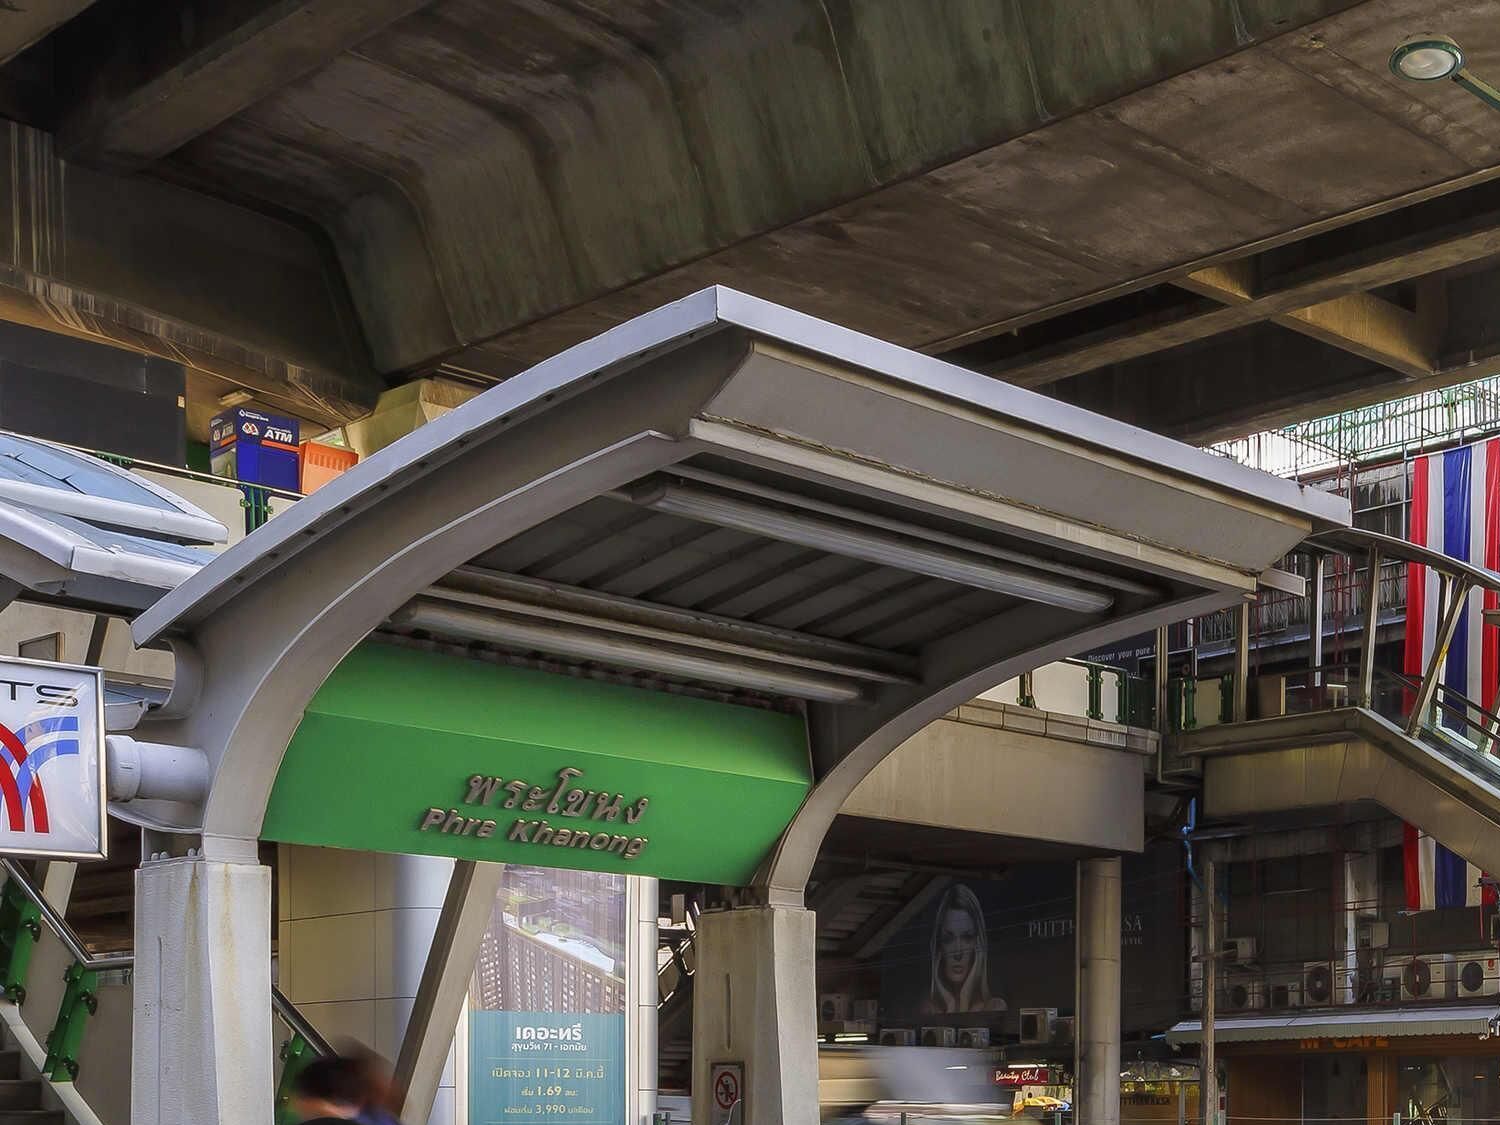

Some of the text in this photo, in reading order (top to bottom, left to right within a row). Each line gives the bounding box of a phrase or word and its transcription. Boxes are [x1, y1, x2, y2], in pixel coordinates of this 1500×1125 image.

[264, 429, 293, 443] ATM
[464, 767, 649, 825] พระโขนง
[420, 807, 649, 859] Phra Khanong
[515, 1022, 583, 1041] เดอะทรี
[535, 1067, 571, 1079] 11-12
[536, 1086, 562, 1097] 1.69
[535, 1104, 566, 1115] 3,990
